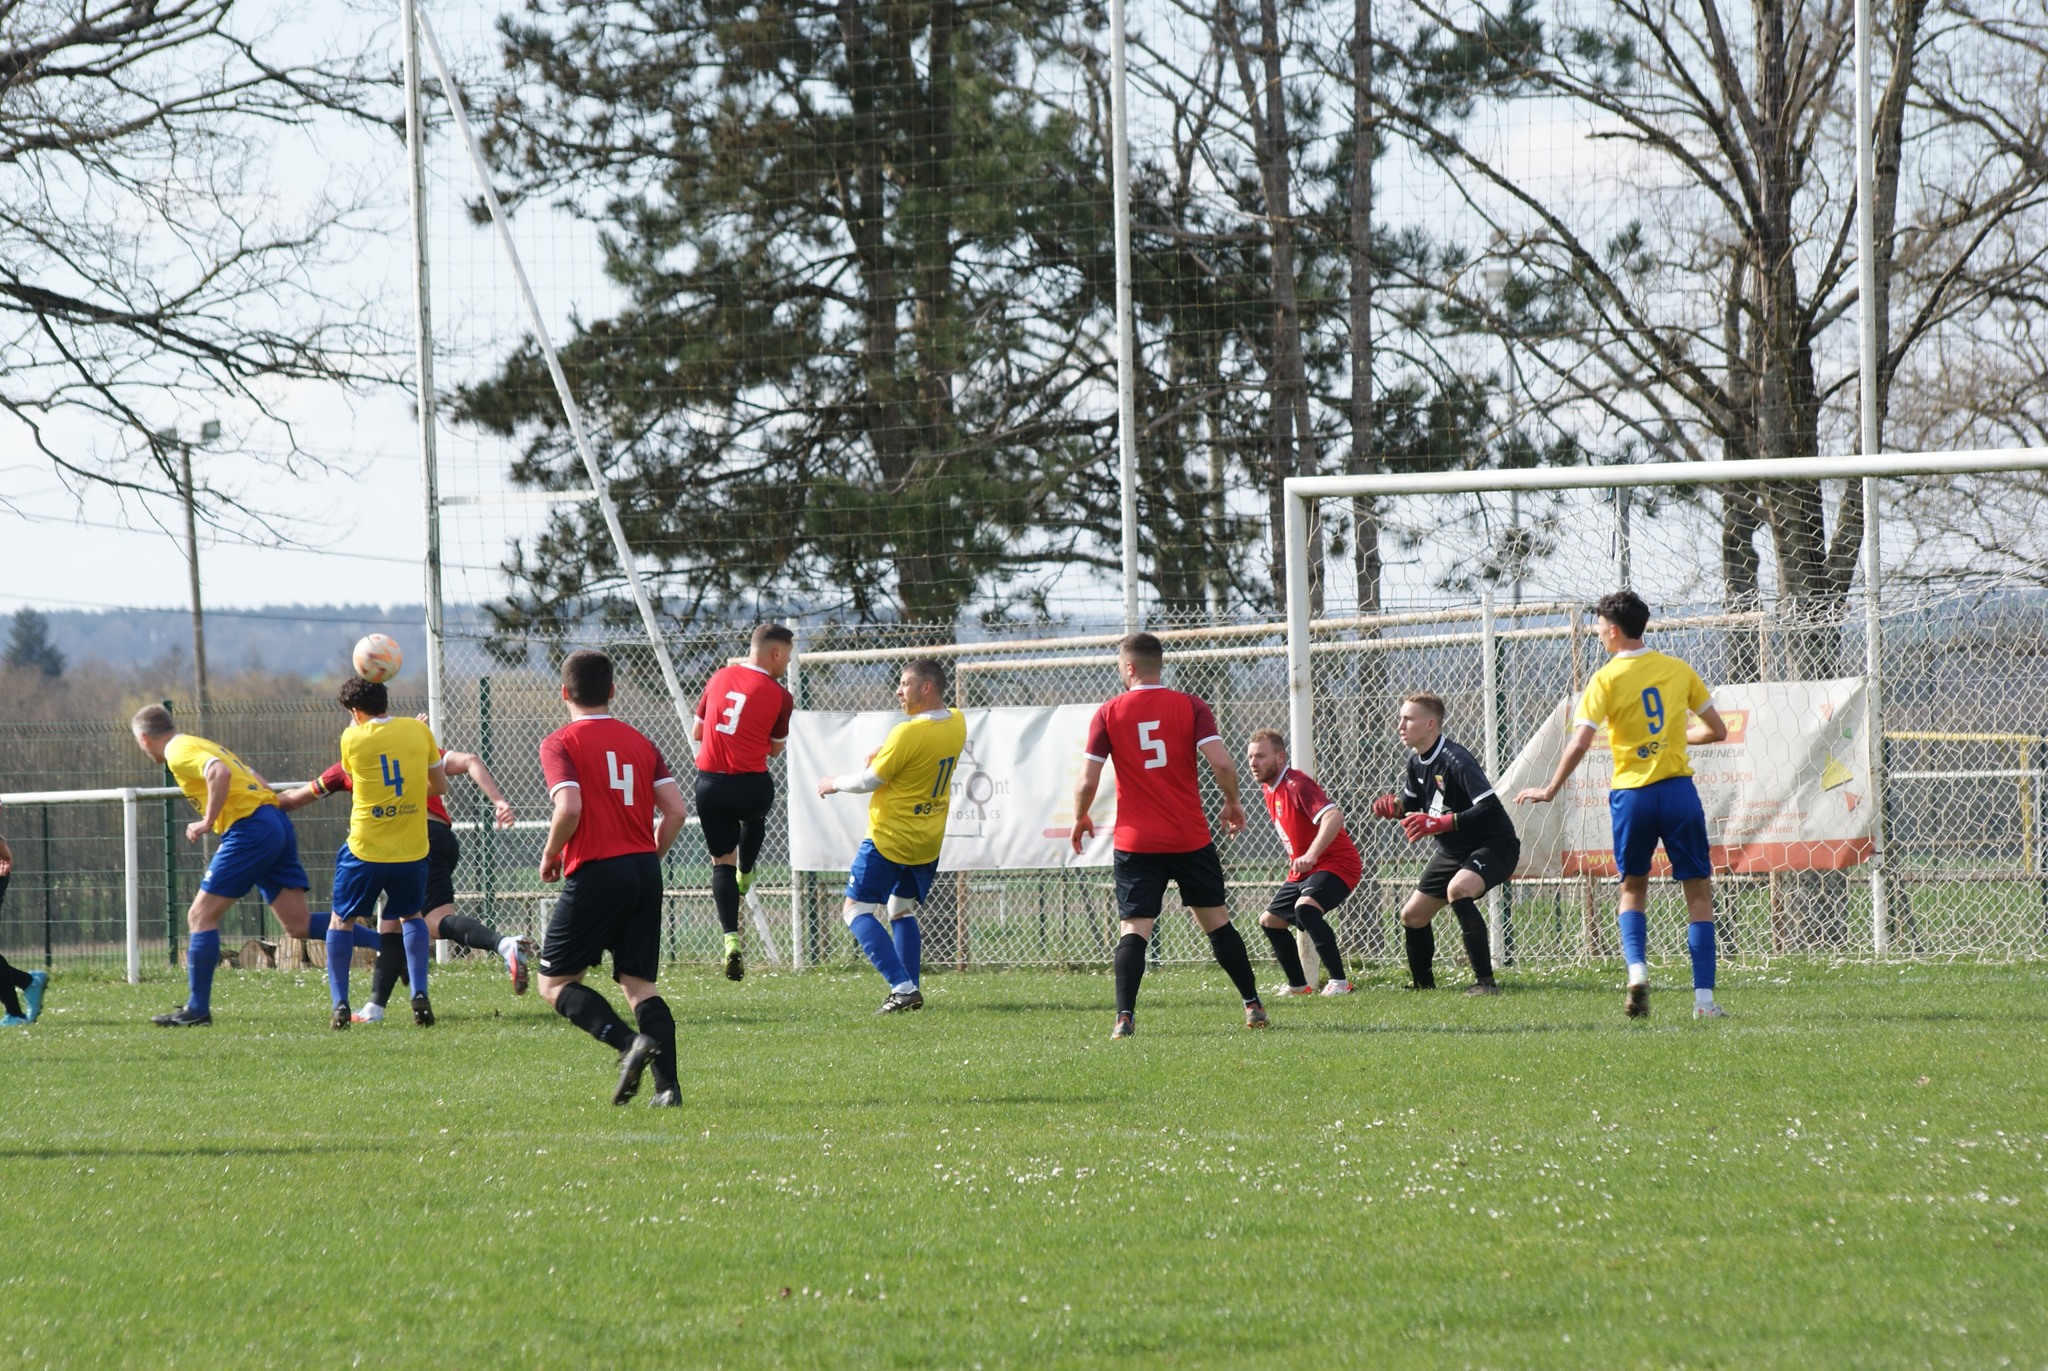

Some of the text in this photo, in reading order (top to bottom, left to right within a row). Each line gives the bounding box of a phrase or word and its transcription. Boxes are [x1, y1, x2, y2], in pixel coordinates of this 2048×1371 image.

[715, 691, 746, 735] 3
[1642, 687, 1664, 734] 9
[1138, 720, 1167, 769] 5
[380, 754, 404, 797] 4
[606, 751, 634, 806] 4
[931, 756, 955, 798] 11
